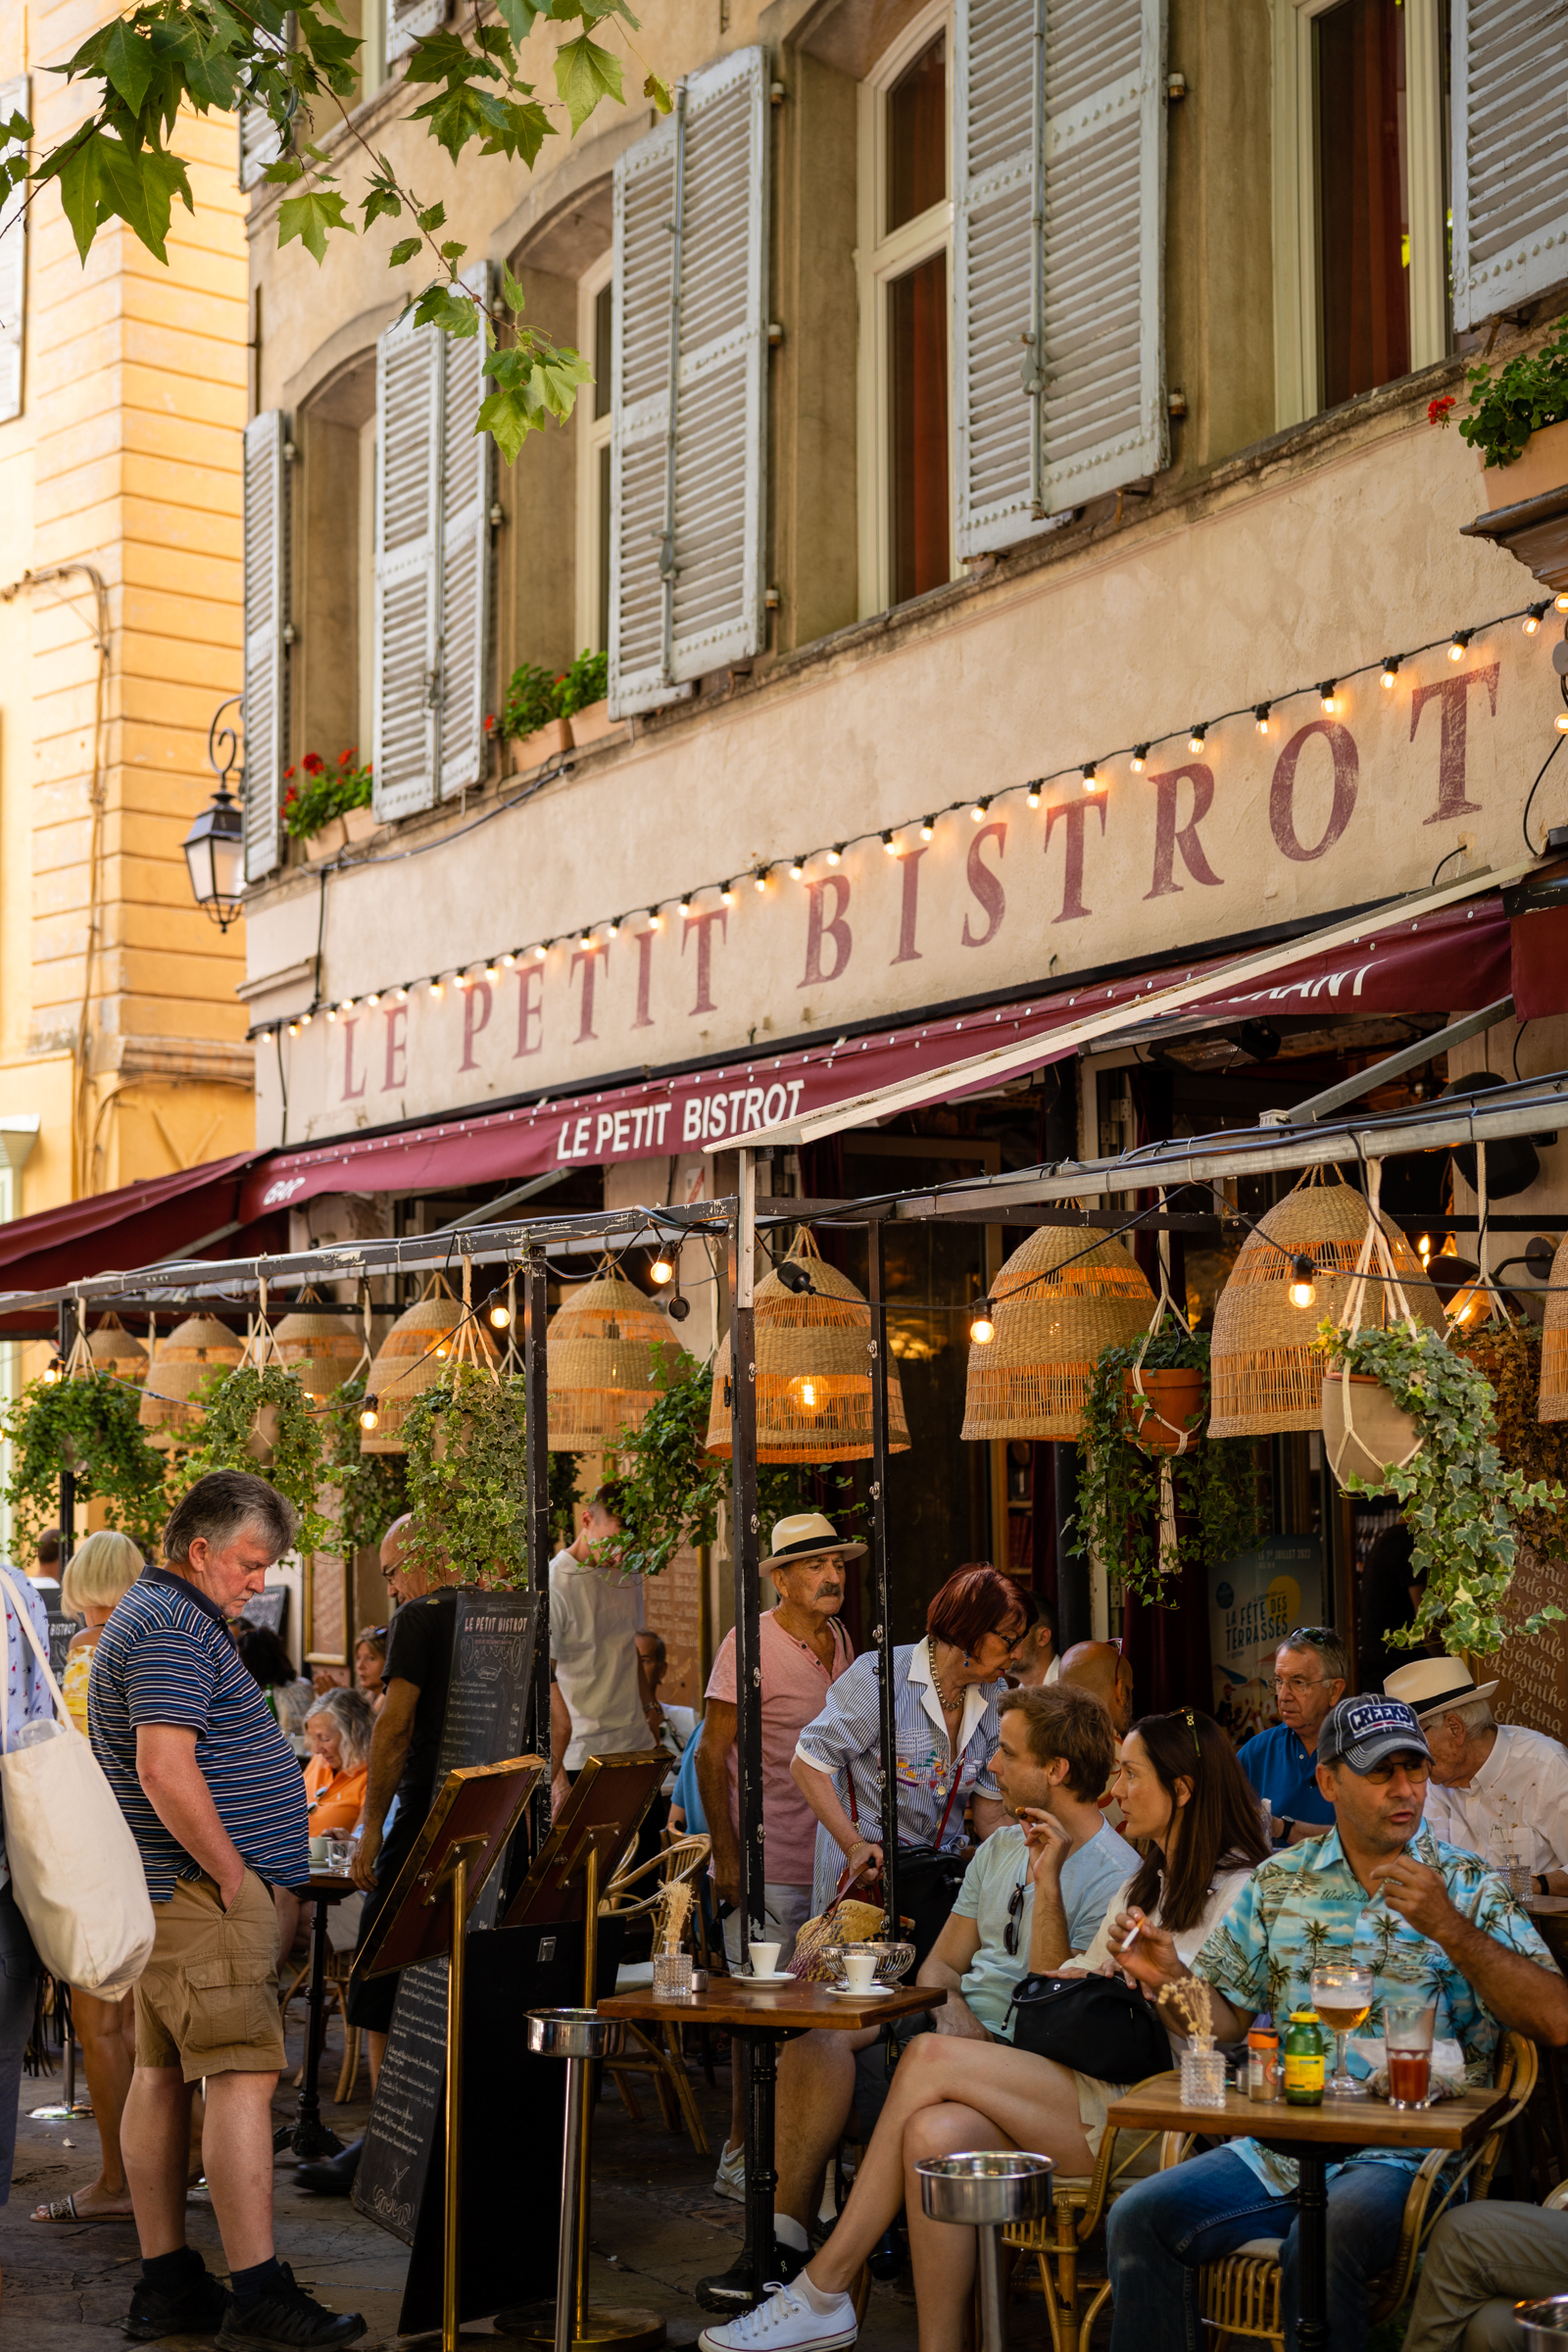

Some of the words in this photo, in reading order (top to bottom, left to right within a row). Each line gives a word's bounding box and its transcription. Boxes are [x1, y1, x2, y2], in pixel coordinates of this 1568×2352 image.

[340, 1004, 409, 1102] LE
[458, 907, 728, 1072] PETIT
[798, 662, 1499, 989] BISTROT
[557, 1119, 588, 1160] LE
[595, 1102, 671, 1154] PETIT
[683, 1079, 805, 1143] BISTROT
[263, 1176, 306, 1206] BAR
[1275, 1548, 1296, 1560] JUILLET
[464, 1617, 473, 1633] LE
[475, 1616, 497, 1632] PETIT
[497, 1617, 528, 1634] BISTROT
[1226, 1610, 1237, 1628] LA
[1241, 1601, 1266, 1627] FÊTE
[1270, 1594, 1288, 1614] DES
[50, 1622, 76, 1637] BISTROT
[1225, 1613, 1289, 1652] TERRASSES
[1503, 1636, 1557, 1683] Génépi
[1349, 1704, 1411, 1732] CREEKS
[1320, 1887, 1345, 1901] West
